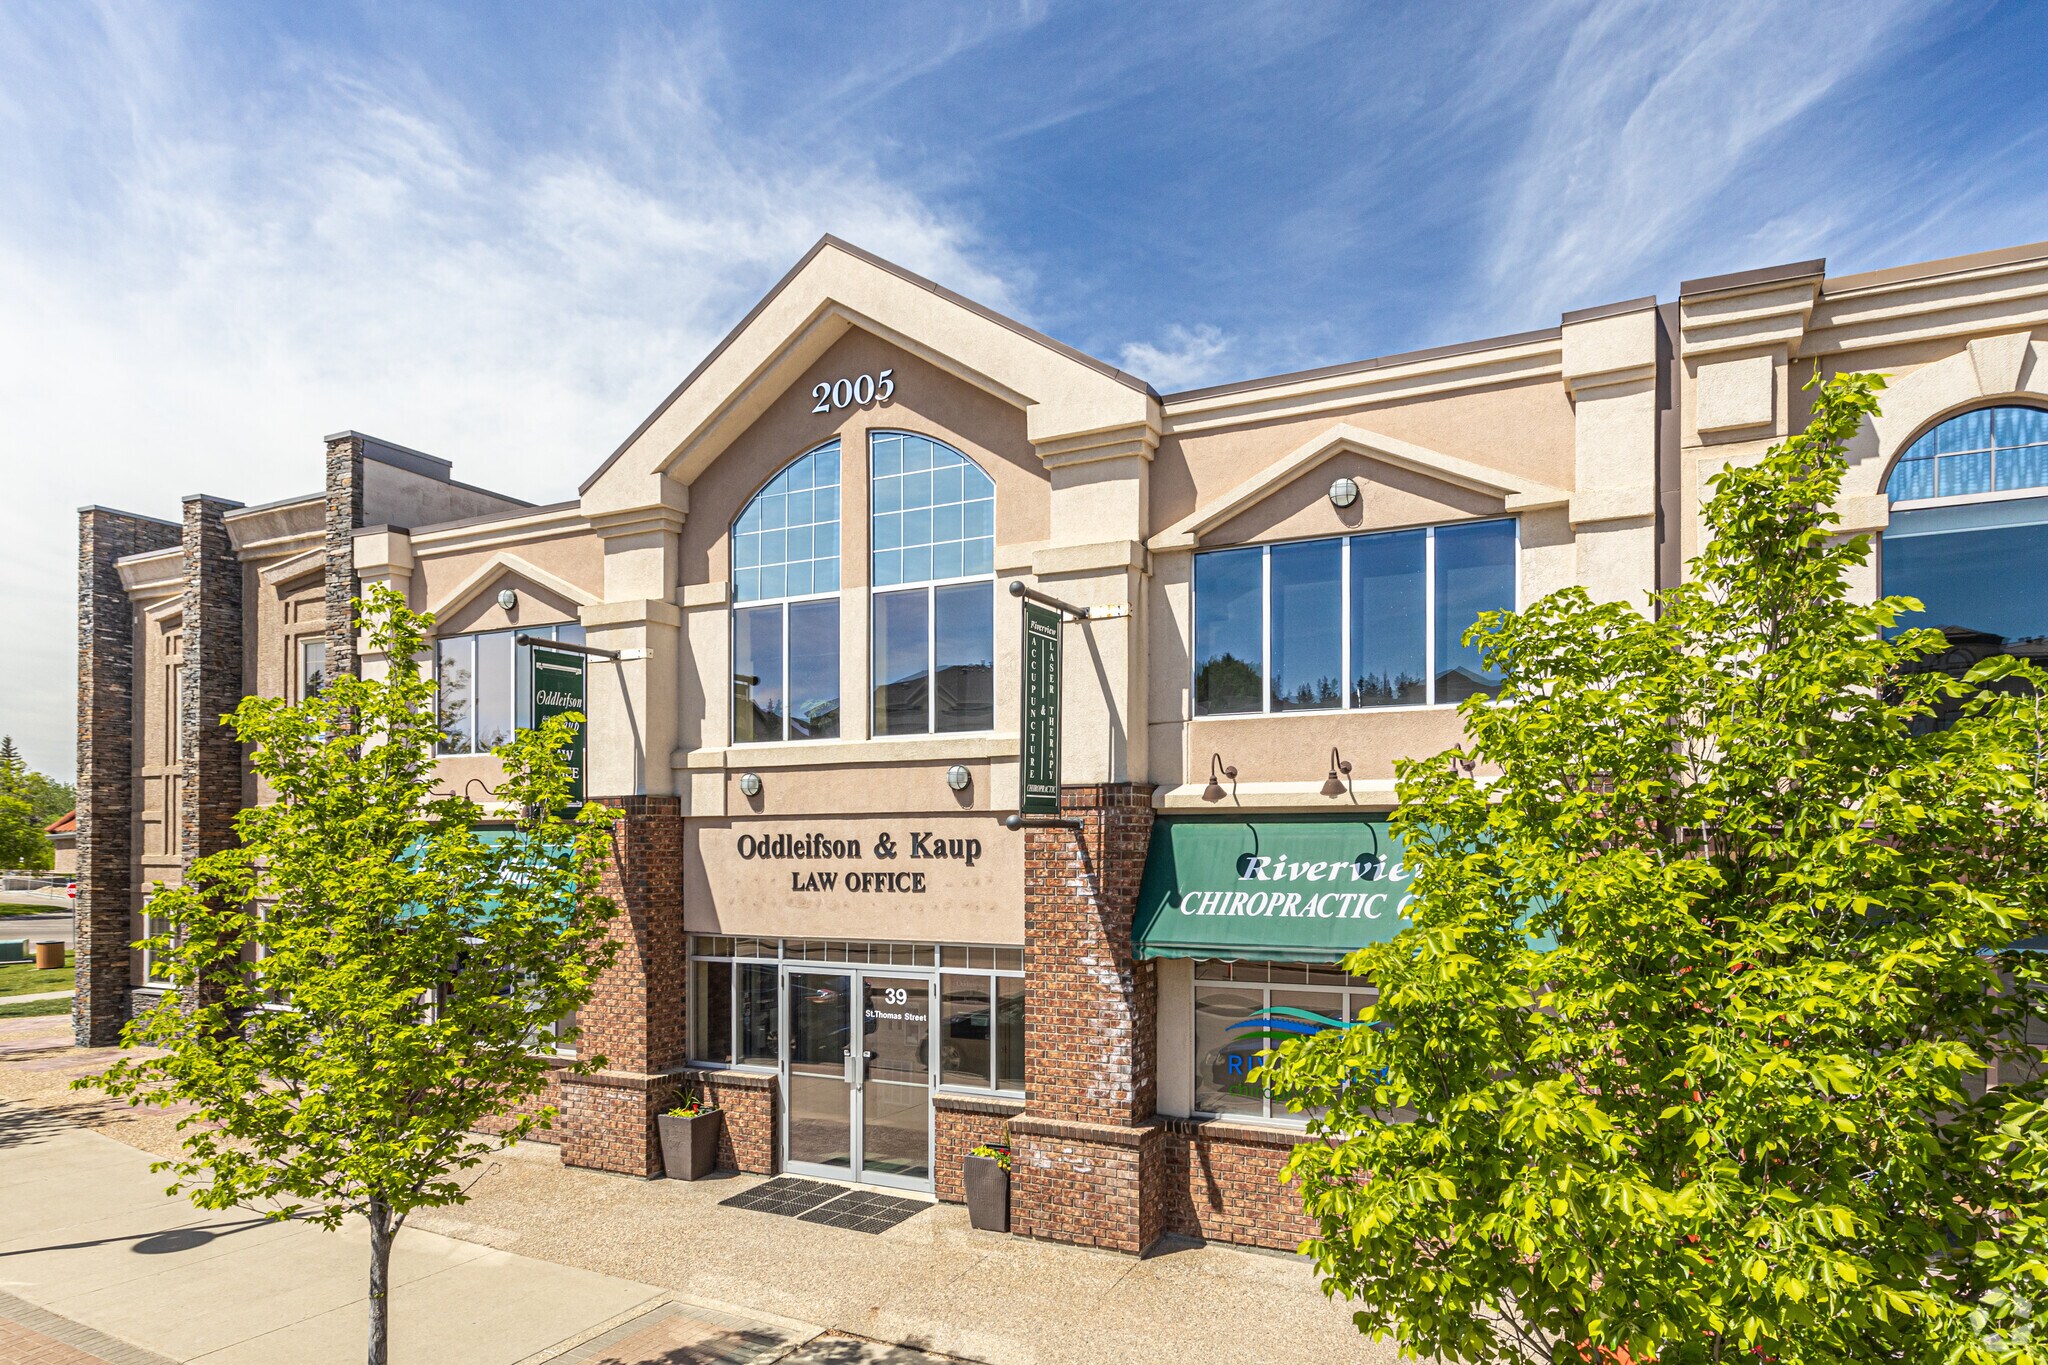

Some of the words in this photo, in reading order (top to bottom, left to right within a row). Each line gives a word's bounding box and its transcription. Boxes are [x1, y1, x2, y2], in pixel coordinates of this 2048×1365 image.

[812, 368, 895, 413] 2005
[1030, 620, 1057, 636] Riverview
[536, 689, 583, 709] Oddleifson
[1029, 637, 1037, 779] ACCUPUNCTURE
[1040, 704, 1046, 716] &
[737, 832, 862, 859] Oddleifson
[874, 831, 897, 859] &
[910, 831, 982, 866] Kaup
[792, 872, 838, 892] LAW
[845, 872, 926, 893] OFFICE
[1180, 891, 1387, 919] CHIROPRACTIC
[884, 988, 907, 1005] 39
[904, 1012, 927, 1022] Street
